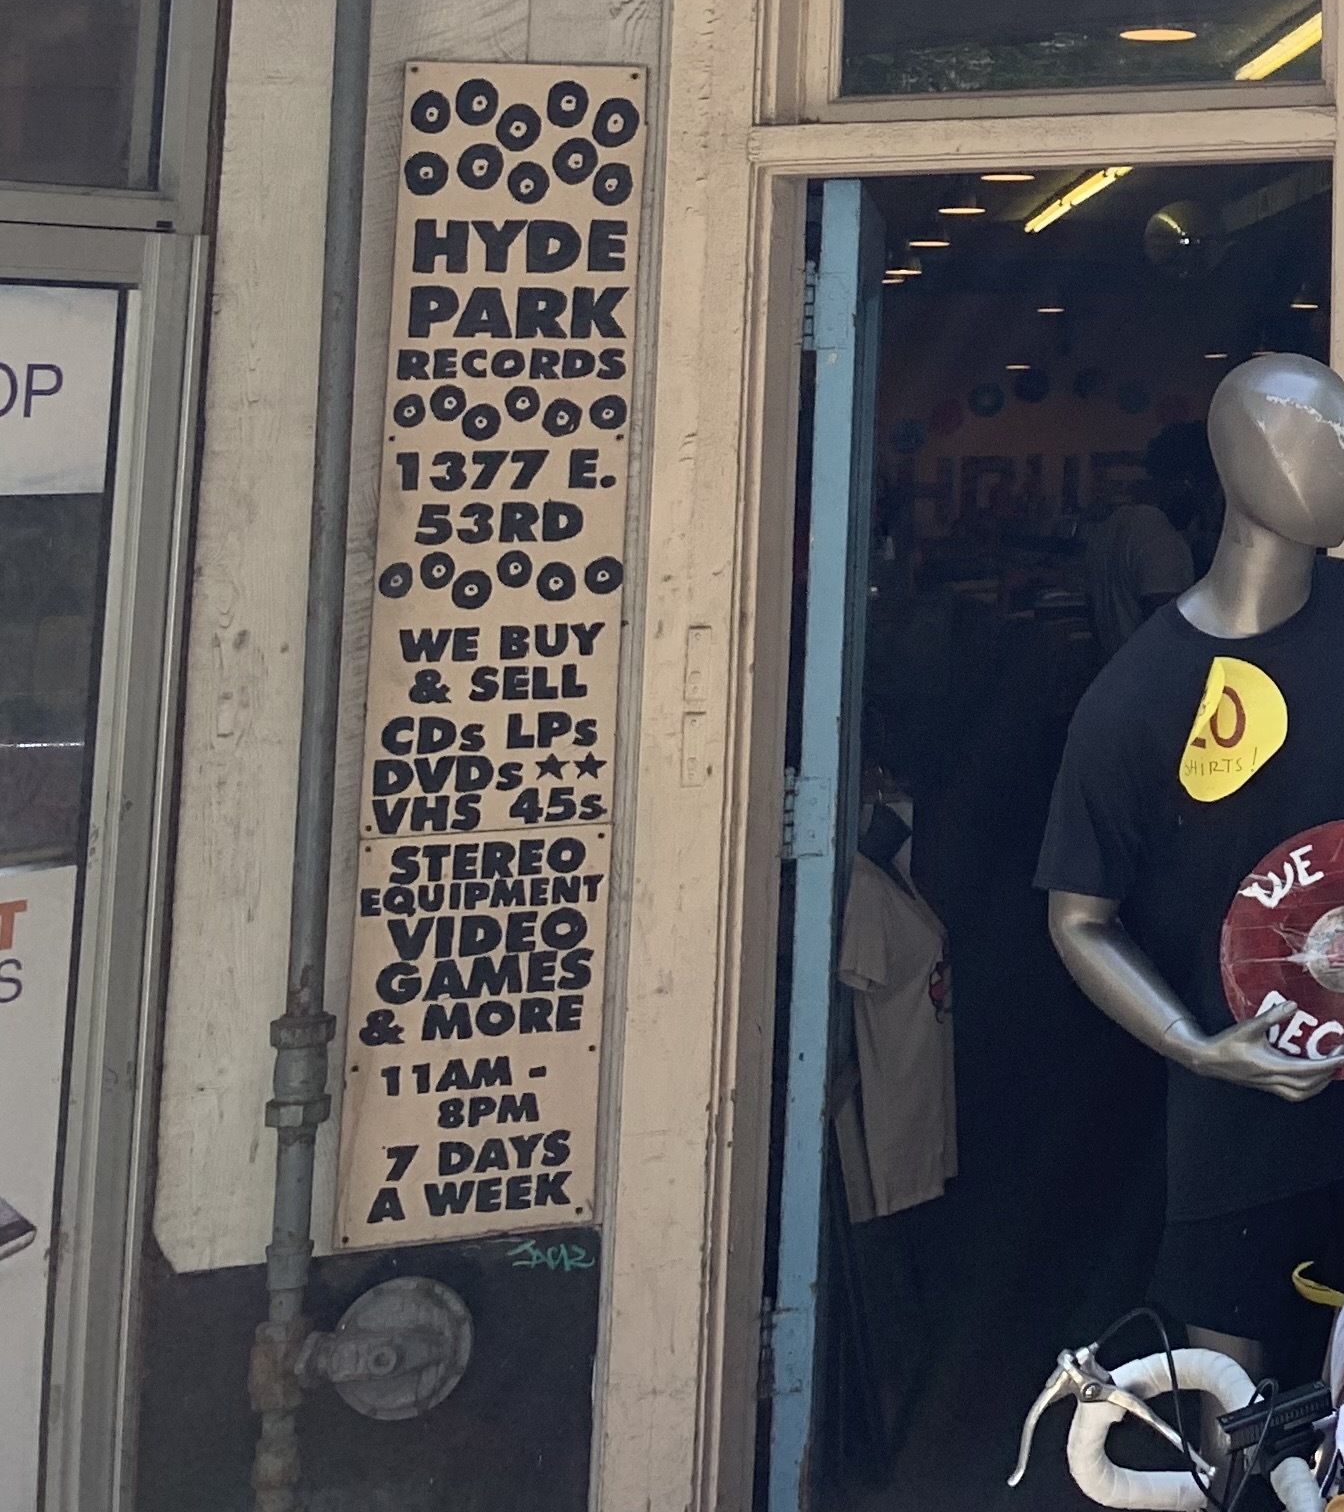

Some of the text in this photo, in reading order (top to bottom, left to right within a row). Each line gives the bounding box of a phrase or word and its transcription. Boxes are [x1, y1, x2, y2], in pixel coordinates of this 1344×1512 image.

[412, 218, 629, 274] HYDE
[407, 285, 631, 340] PARK
[396, 347, 627, 381] RECORDS
[396, 448, 617, 493] 1377 E.
[414, 498, 585, 546] 53RD
[399, 621, 605, 663] WE BUY
[408, 663, 588, 705] & SELL
[380, 710, 599, 756] CDs LPs
[372, 754, 524, 798] DVDs
[372, 787, 608, 836] VHS 45s
[388, 836, 587, 887] STEREO
[1239, 843, 1325, 909] WE
[359, 873, 604, 917] EQUIPMENT
[387, 908, 588, 962] VIDEO
[374, 947, 595, 1006] GAMES
[358, 994, 585, 1047] & MORE
[381, 1055, 512, 1097] 11AM
[437, 1092, 540, 1130] 8PM
[385, 1129, 571, 1184] 7 DAYS
[367, 1169, 572, 1225] A WEEK
